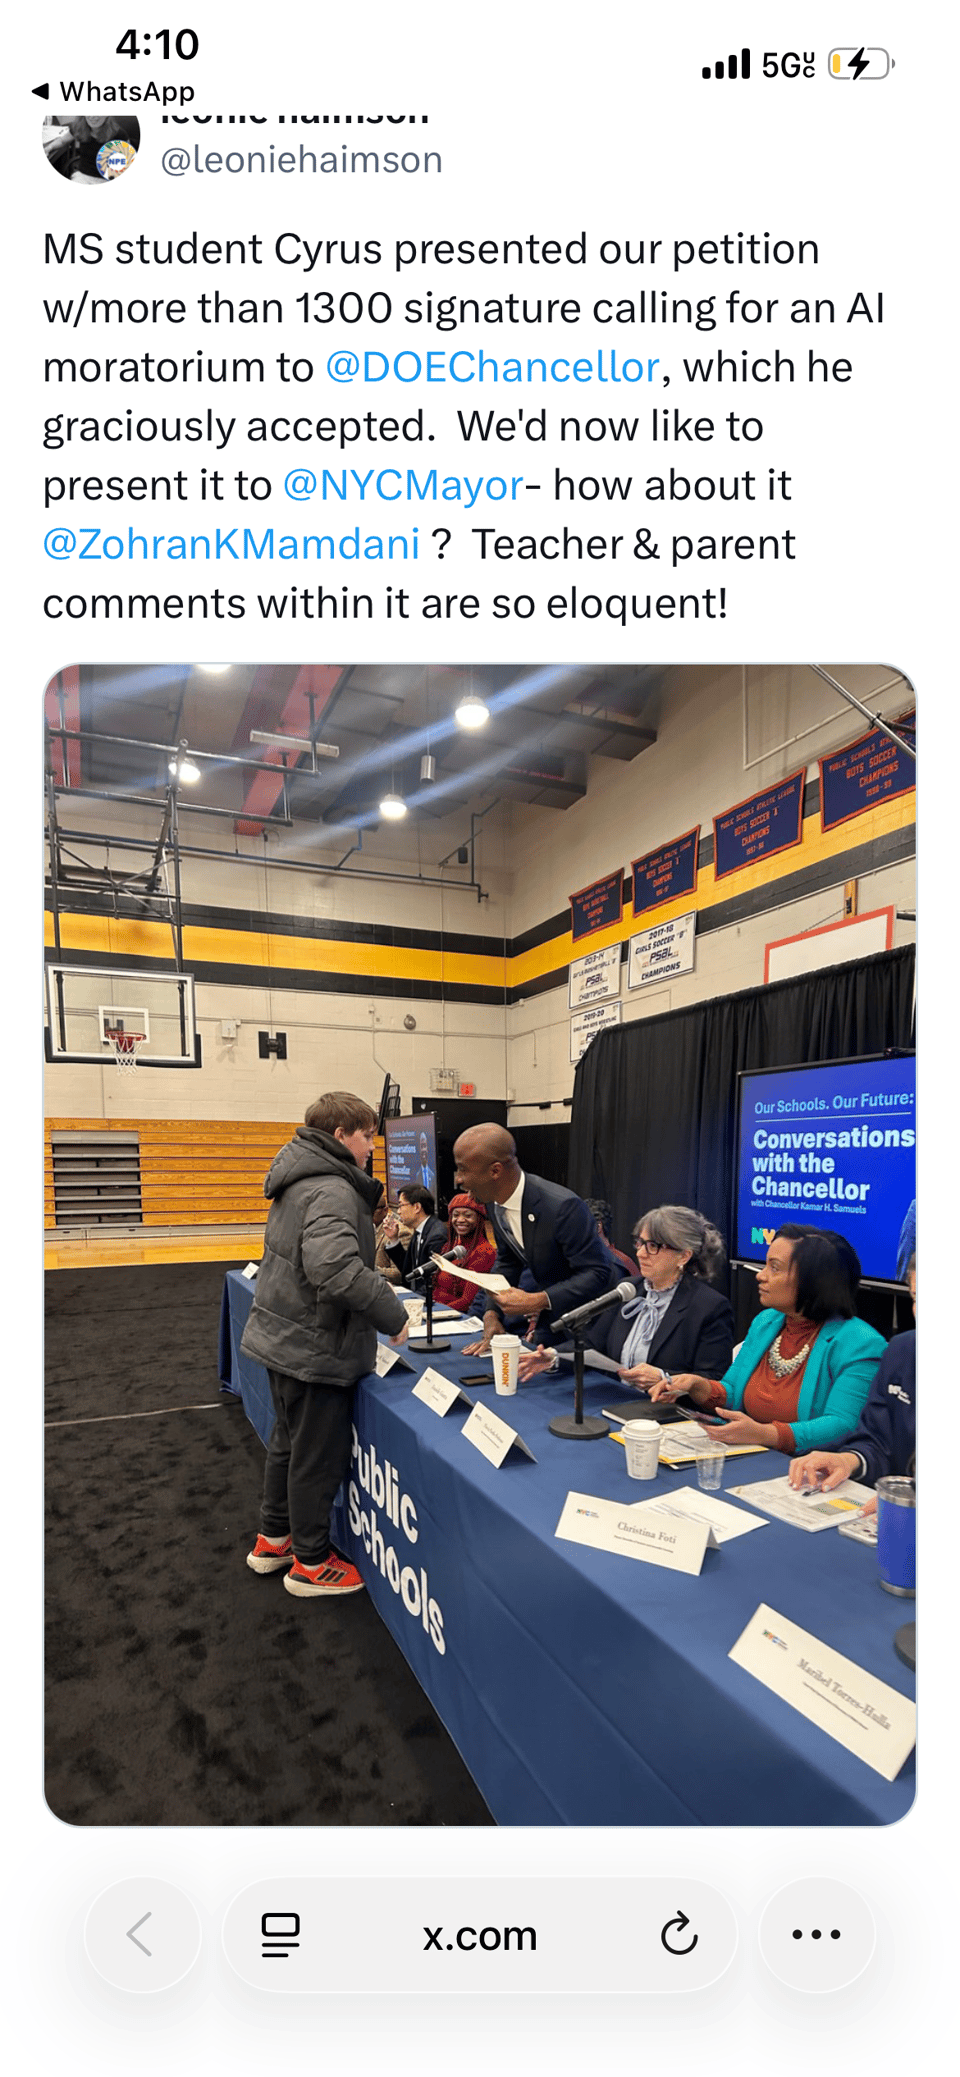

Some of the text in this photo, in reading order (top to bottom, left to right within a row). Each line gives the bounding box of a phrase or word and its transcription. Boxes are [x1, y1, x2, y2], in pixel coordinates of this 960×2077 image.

[845, 745, 898, 780] BOYS SOCCER
[859, 760, 900, 788] CHAMPIONS
[734, 822, 748, 837] BOYS
[749, 810, 771, 828] SOCCER
[741, 825, 771, 847] CHAMPIONS
[648, 924, 675, 941] 2017-18
[635, 942, 652, 955] GIRLS
[652, 934, 675, 949] SOCCER
[641, 961, 681, 981] CHAMPIONS
[584, 1009, 605, 1022] 2019-20
[754, 1092, 914, 1115] Our Schools. Our Future:
[753, 1124, 917, 1150] Conversations
[752, 1151, 836, 1174] with the
[752, 1175, 871, 1201] Chancellor
[751, 1198, 765, 1208] with
[765, 1199, 800, 1210] Chancellor
[824, 1203, 833, 1212] H.
[751, 1226, 776, 1246] NY
[617, 1521, 656, 1539] Christina
[658, 1531, 677, 1544] Foti
[349, 1480, 447, 1656] Schools
